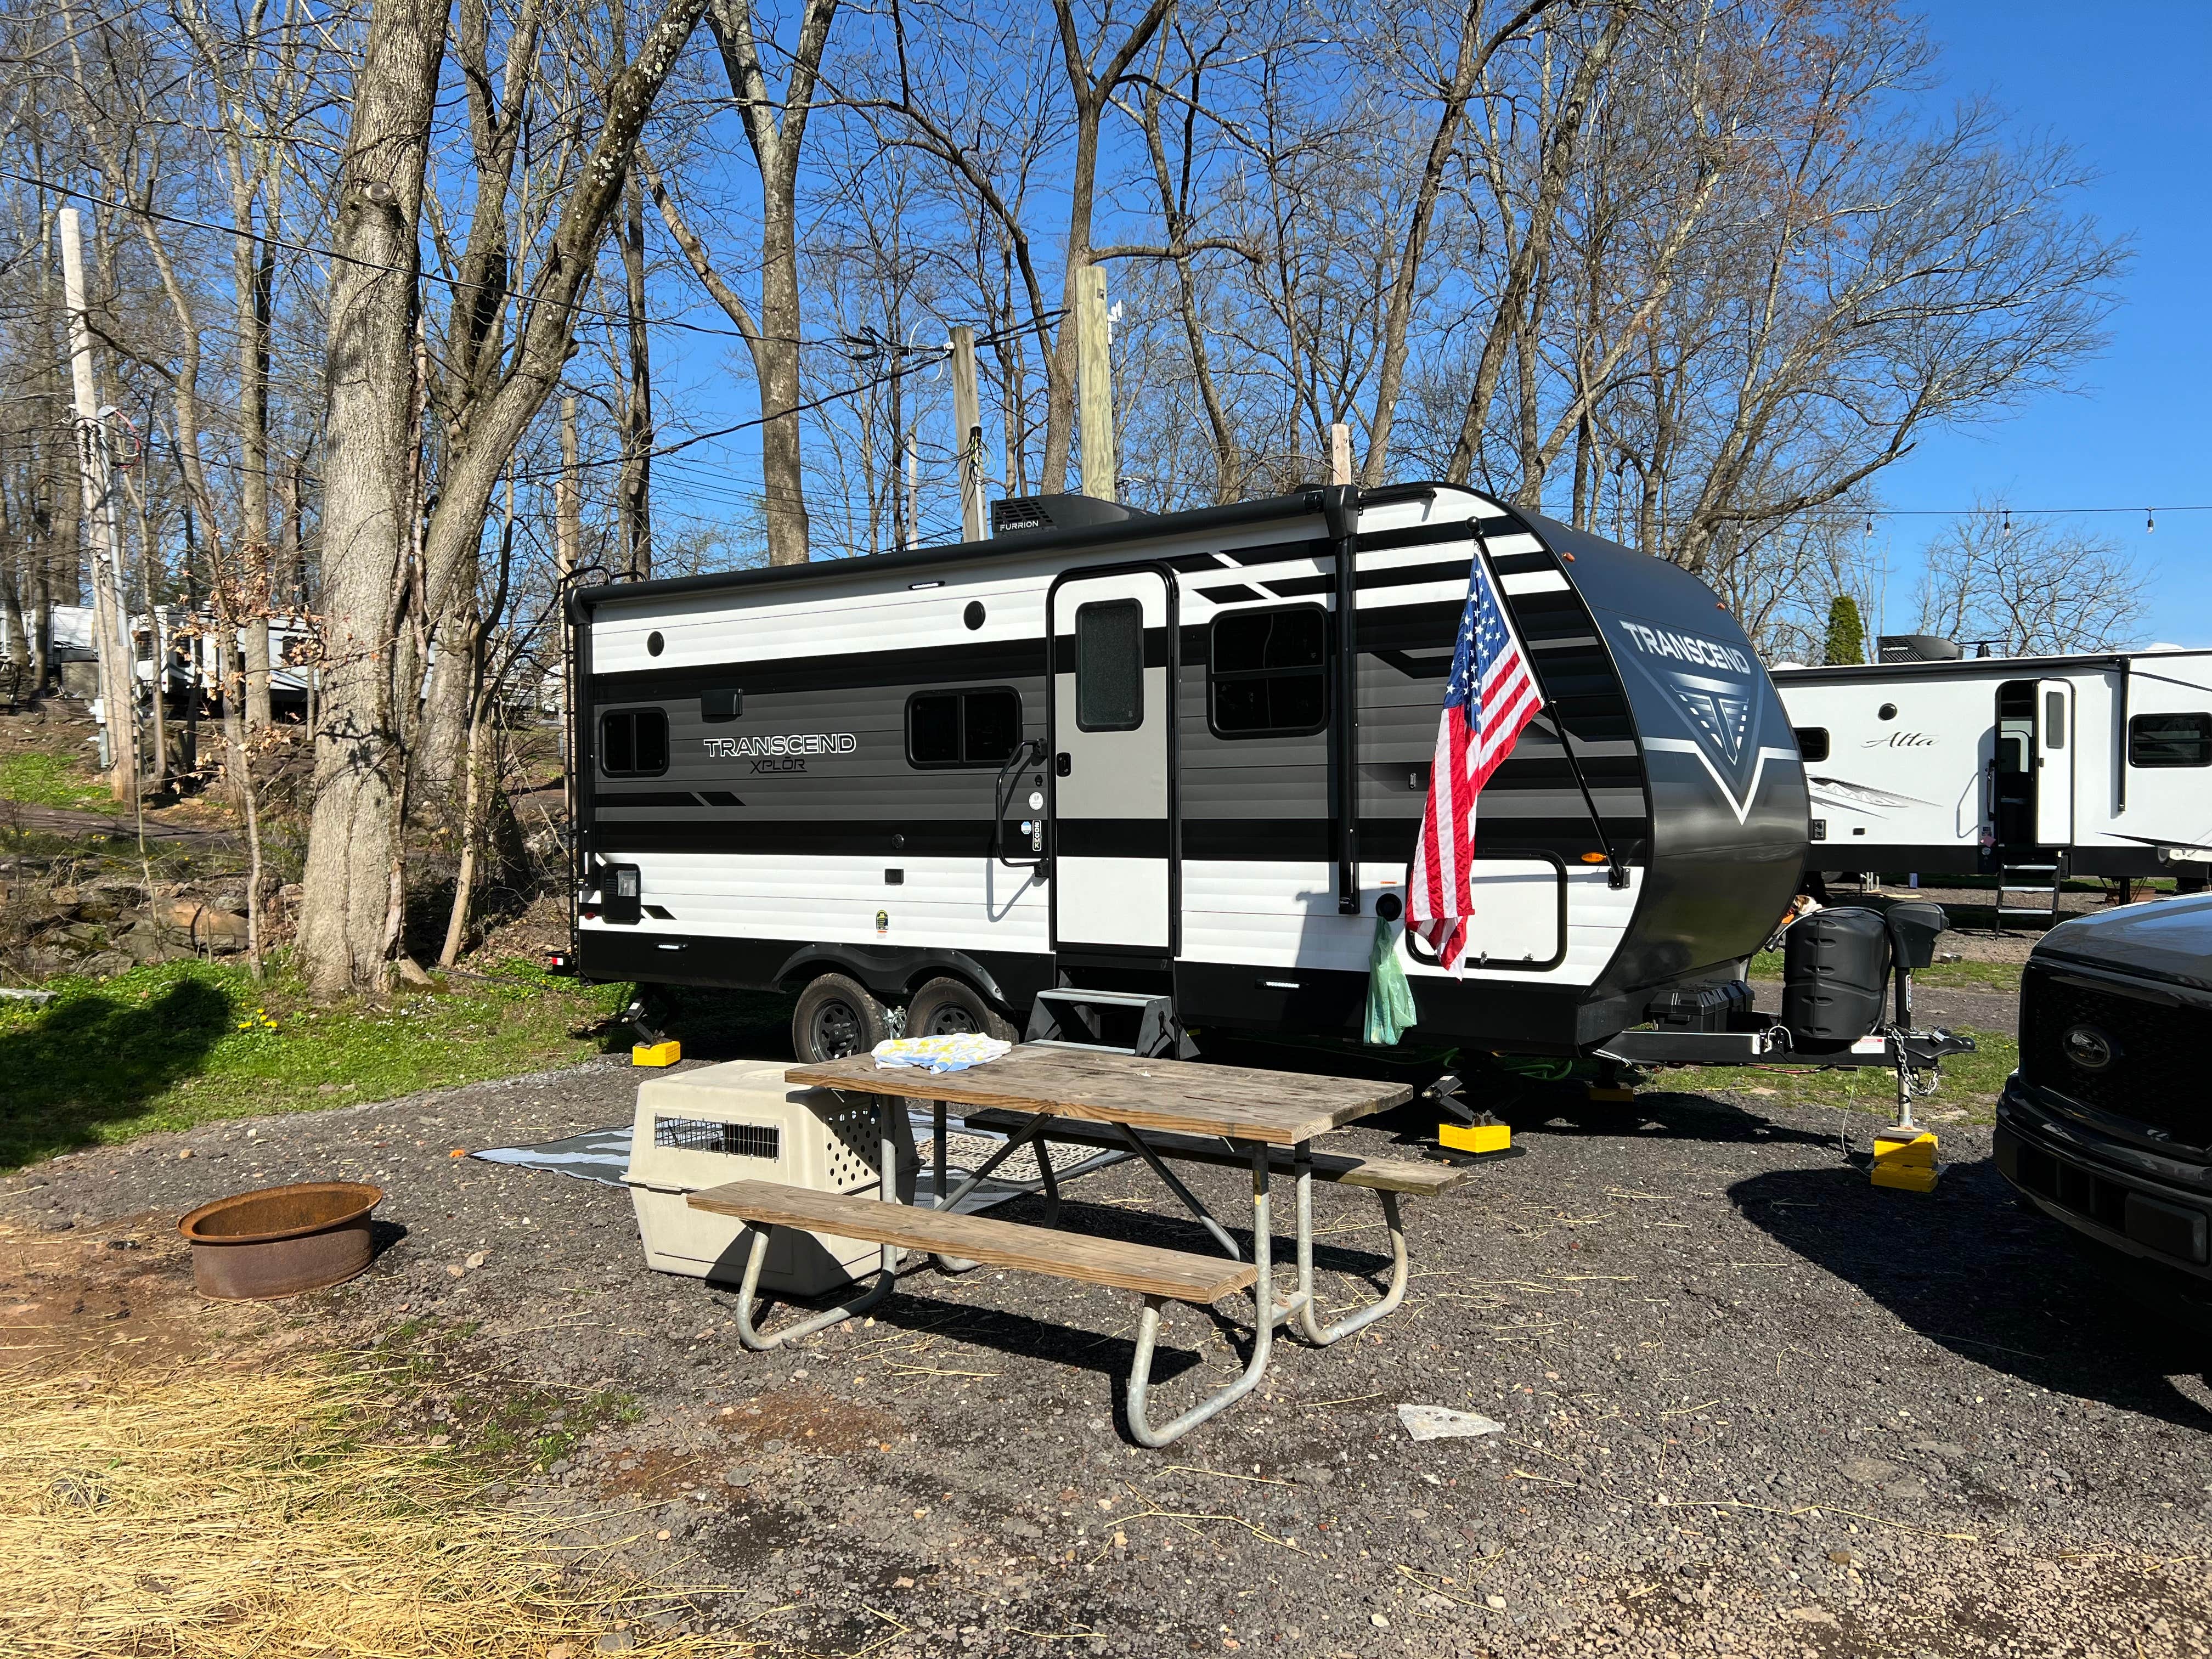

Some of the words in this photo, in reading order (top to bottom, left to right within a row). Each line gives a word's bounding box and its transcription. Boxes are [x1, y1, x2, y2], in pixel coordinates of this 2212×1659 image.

[1000, 520, 1039, 531] FURRION
[1619, 619, 1751, 675] TRANSCEND
[703, 733, 856, 758] TRANSCEND
[1861, 731, 1940, 748] Alta
